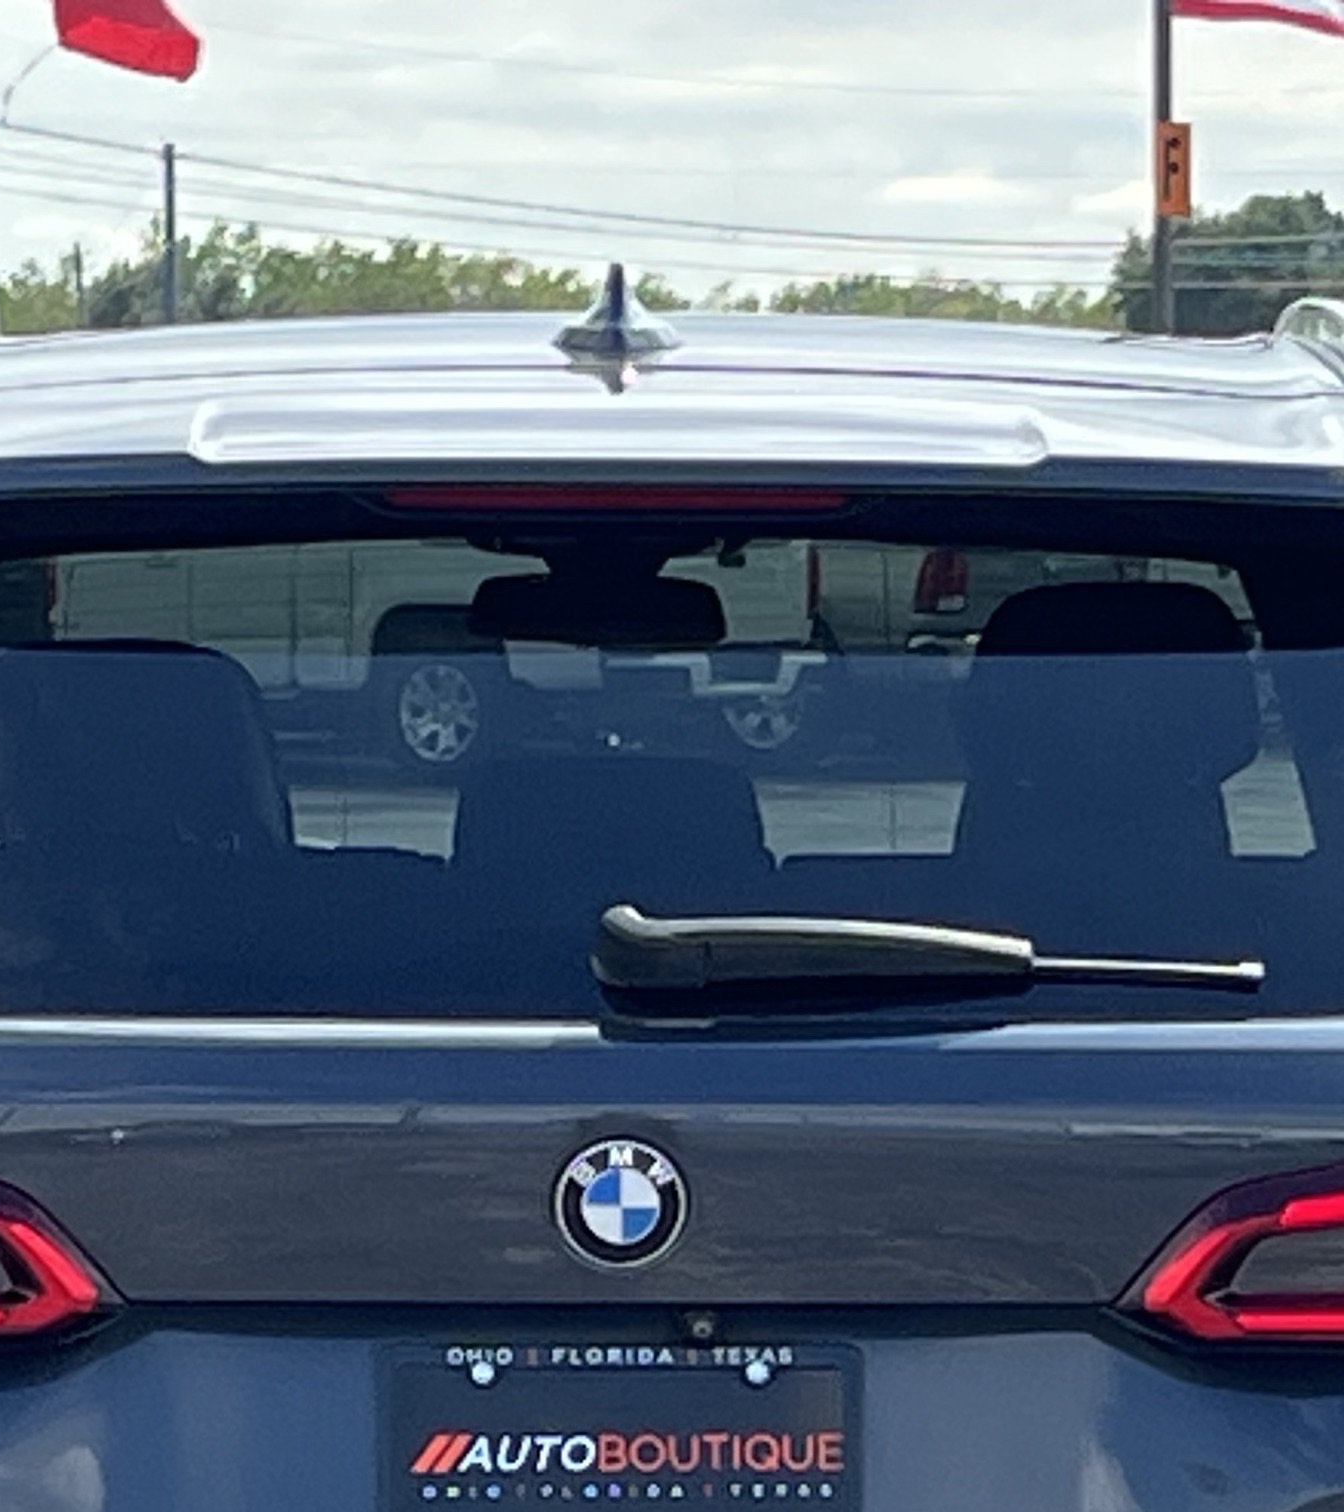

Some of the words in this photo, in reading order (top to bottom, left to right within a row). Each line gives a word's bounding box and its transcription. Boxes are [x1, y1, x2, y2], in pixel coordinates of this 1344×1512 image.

[570, 1146, 675, 1188] BMW
[446, 1347, 513, 1366] OHIO
[551, 1347, 675, 1366] FLORIDA
[711, 1347, 794, 1366] TEXAS
[458, 1433, 844, 1473] AUTOBOUTIQUE
